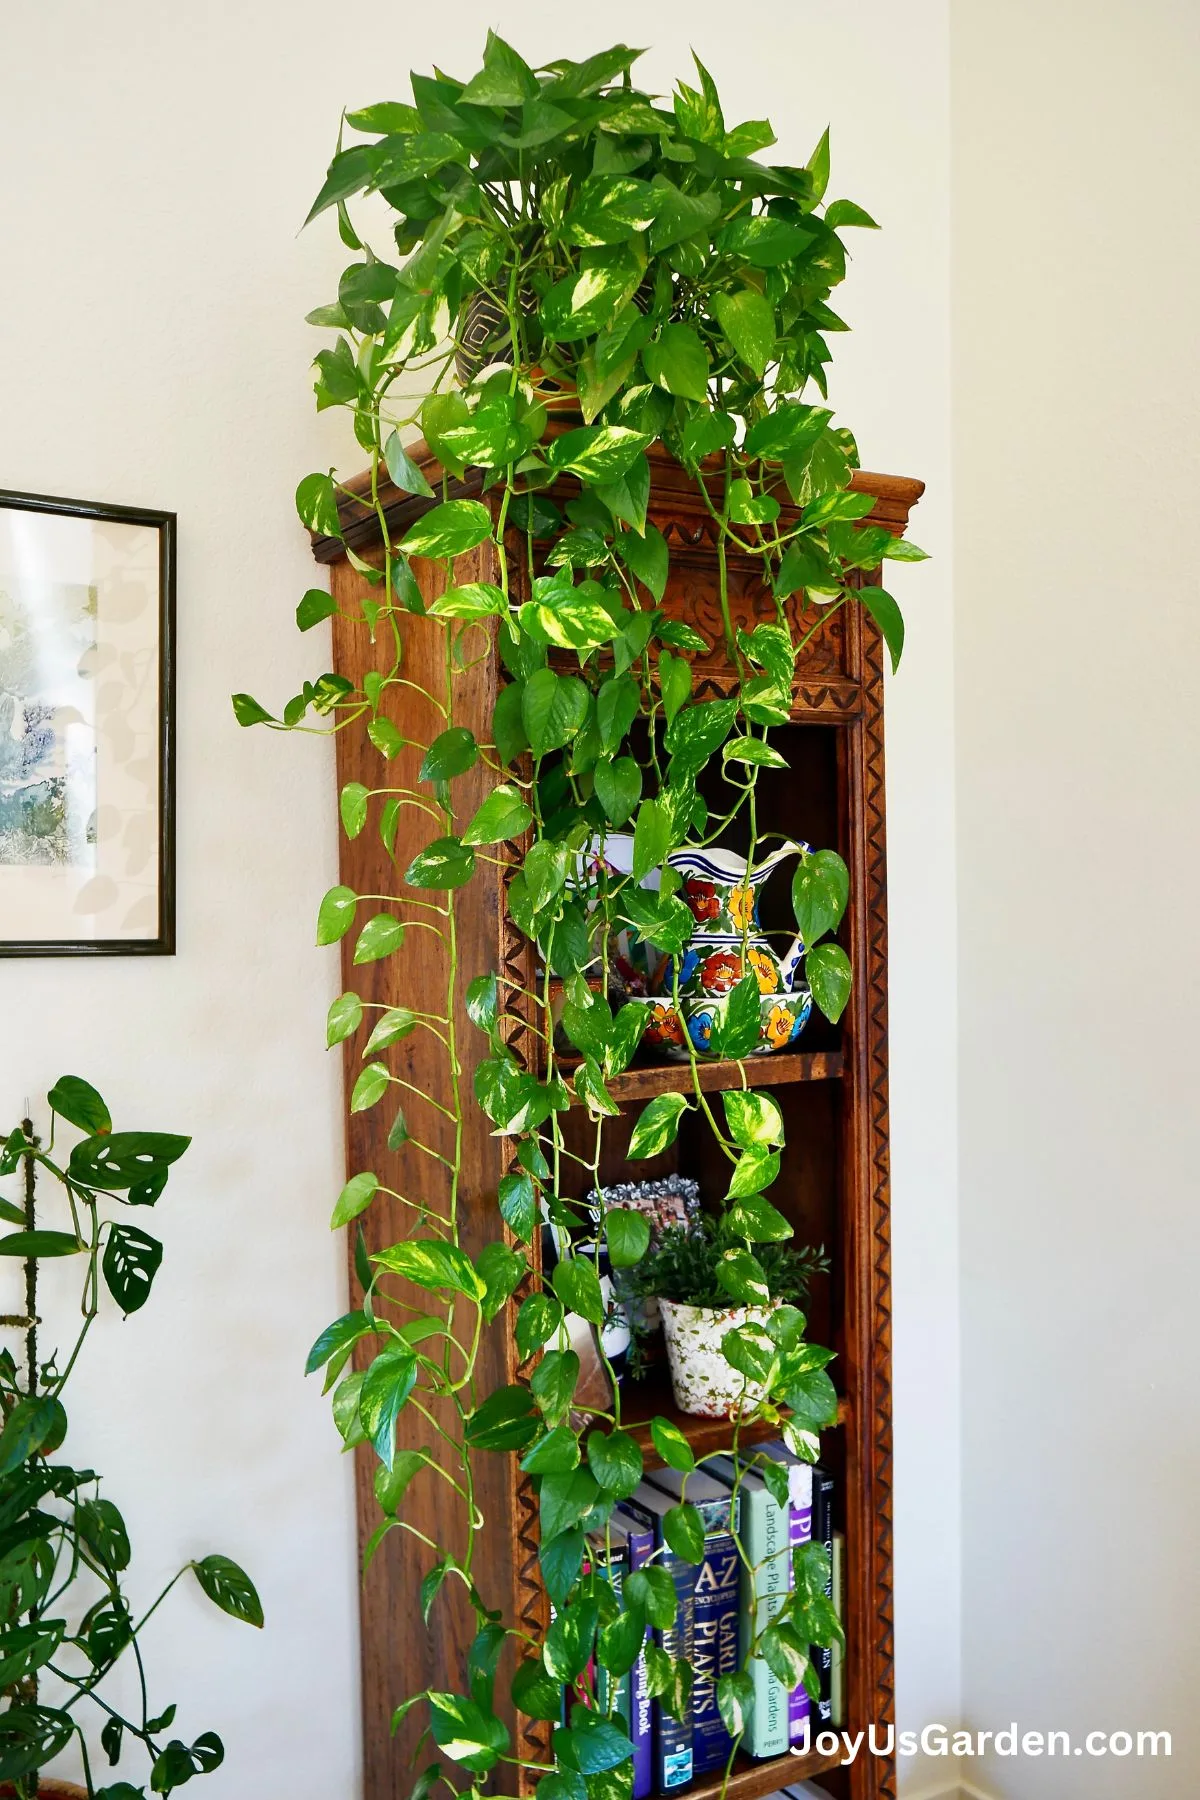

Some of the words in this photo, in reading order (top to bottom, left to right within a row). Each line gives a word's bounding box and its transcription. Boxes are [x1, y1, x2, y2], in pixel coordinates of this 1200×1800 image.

[694, 1555, 738, 1593] A-Z
[693, 1620, 718, 1714] PLANTS
[719, 1611, 737, 1676] GARD
[638, 1699, 651, 1736] Book
[768, 1686, 780, 1733] Gardens
